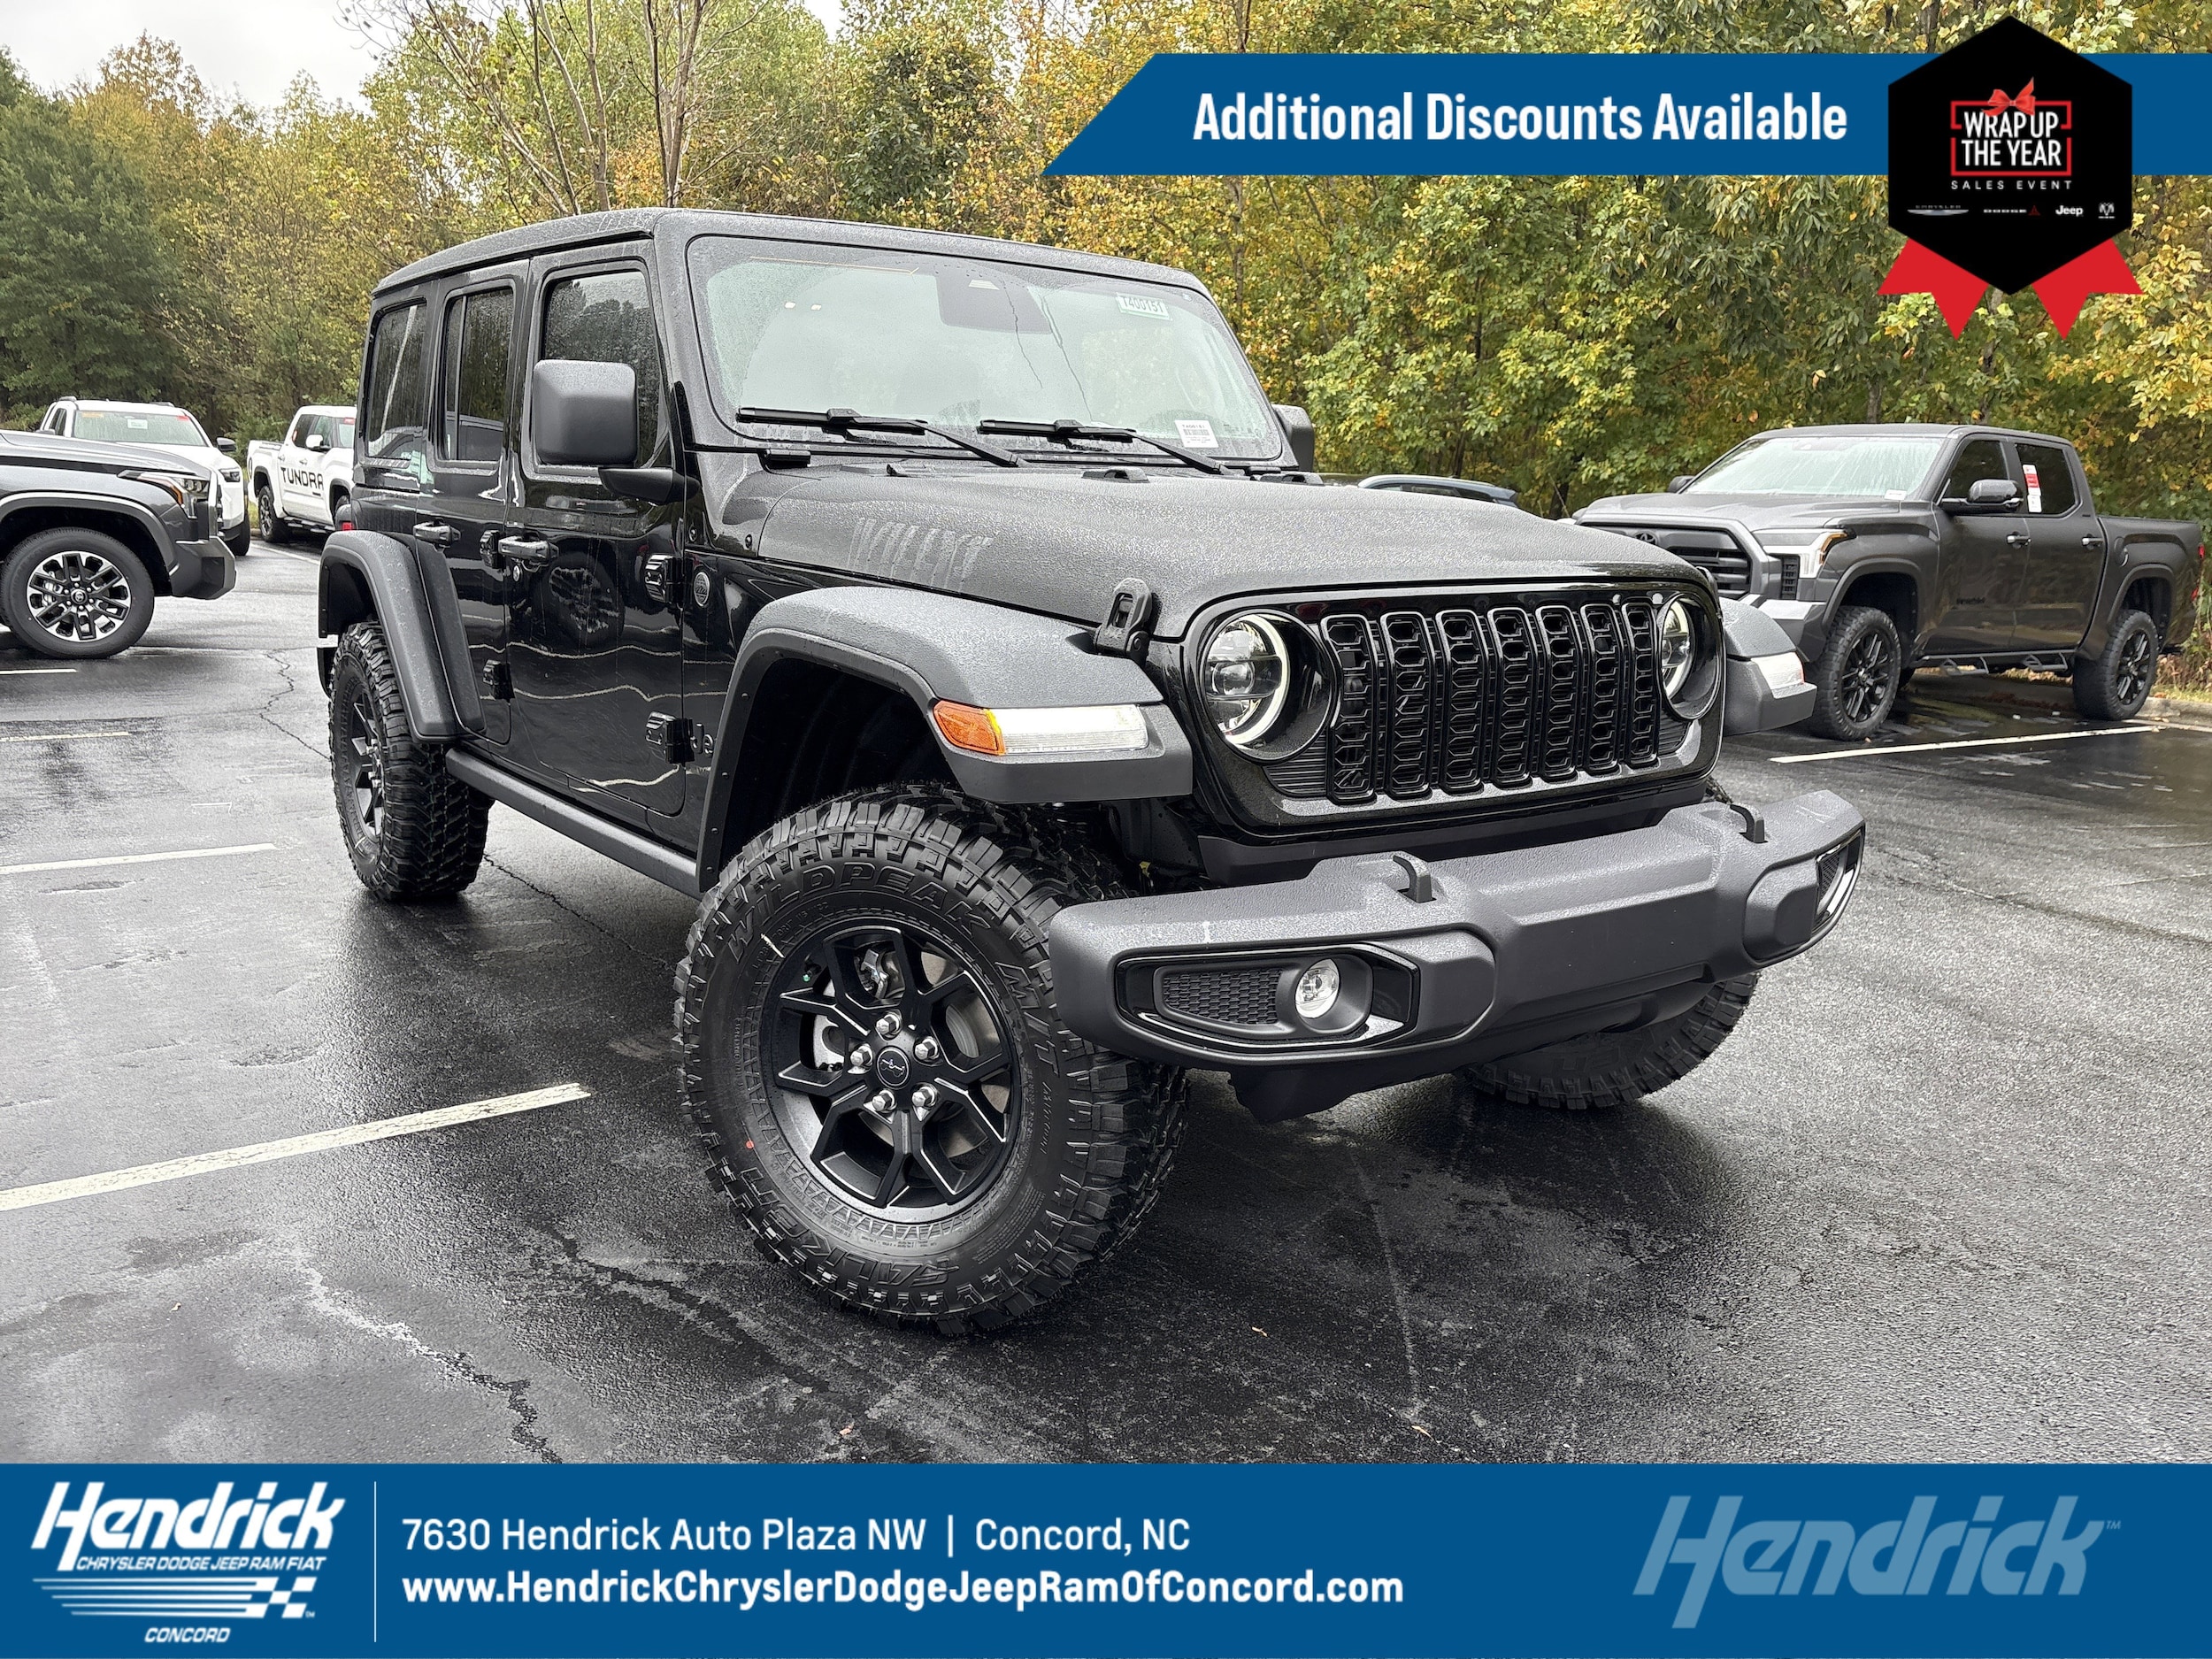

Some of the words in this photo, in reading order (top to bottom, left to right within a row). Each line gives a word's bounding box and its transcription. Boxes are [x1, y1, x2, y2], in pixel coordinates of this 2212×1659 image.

[1120, 296, 1164, 313] T400151
[280, 466, 325, 490] TUNDRA
[726, 861, 992, 963] WILDPEAK
